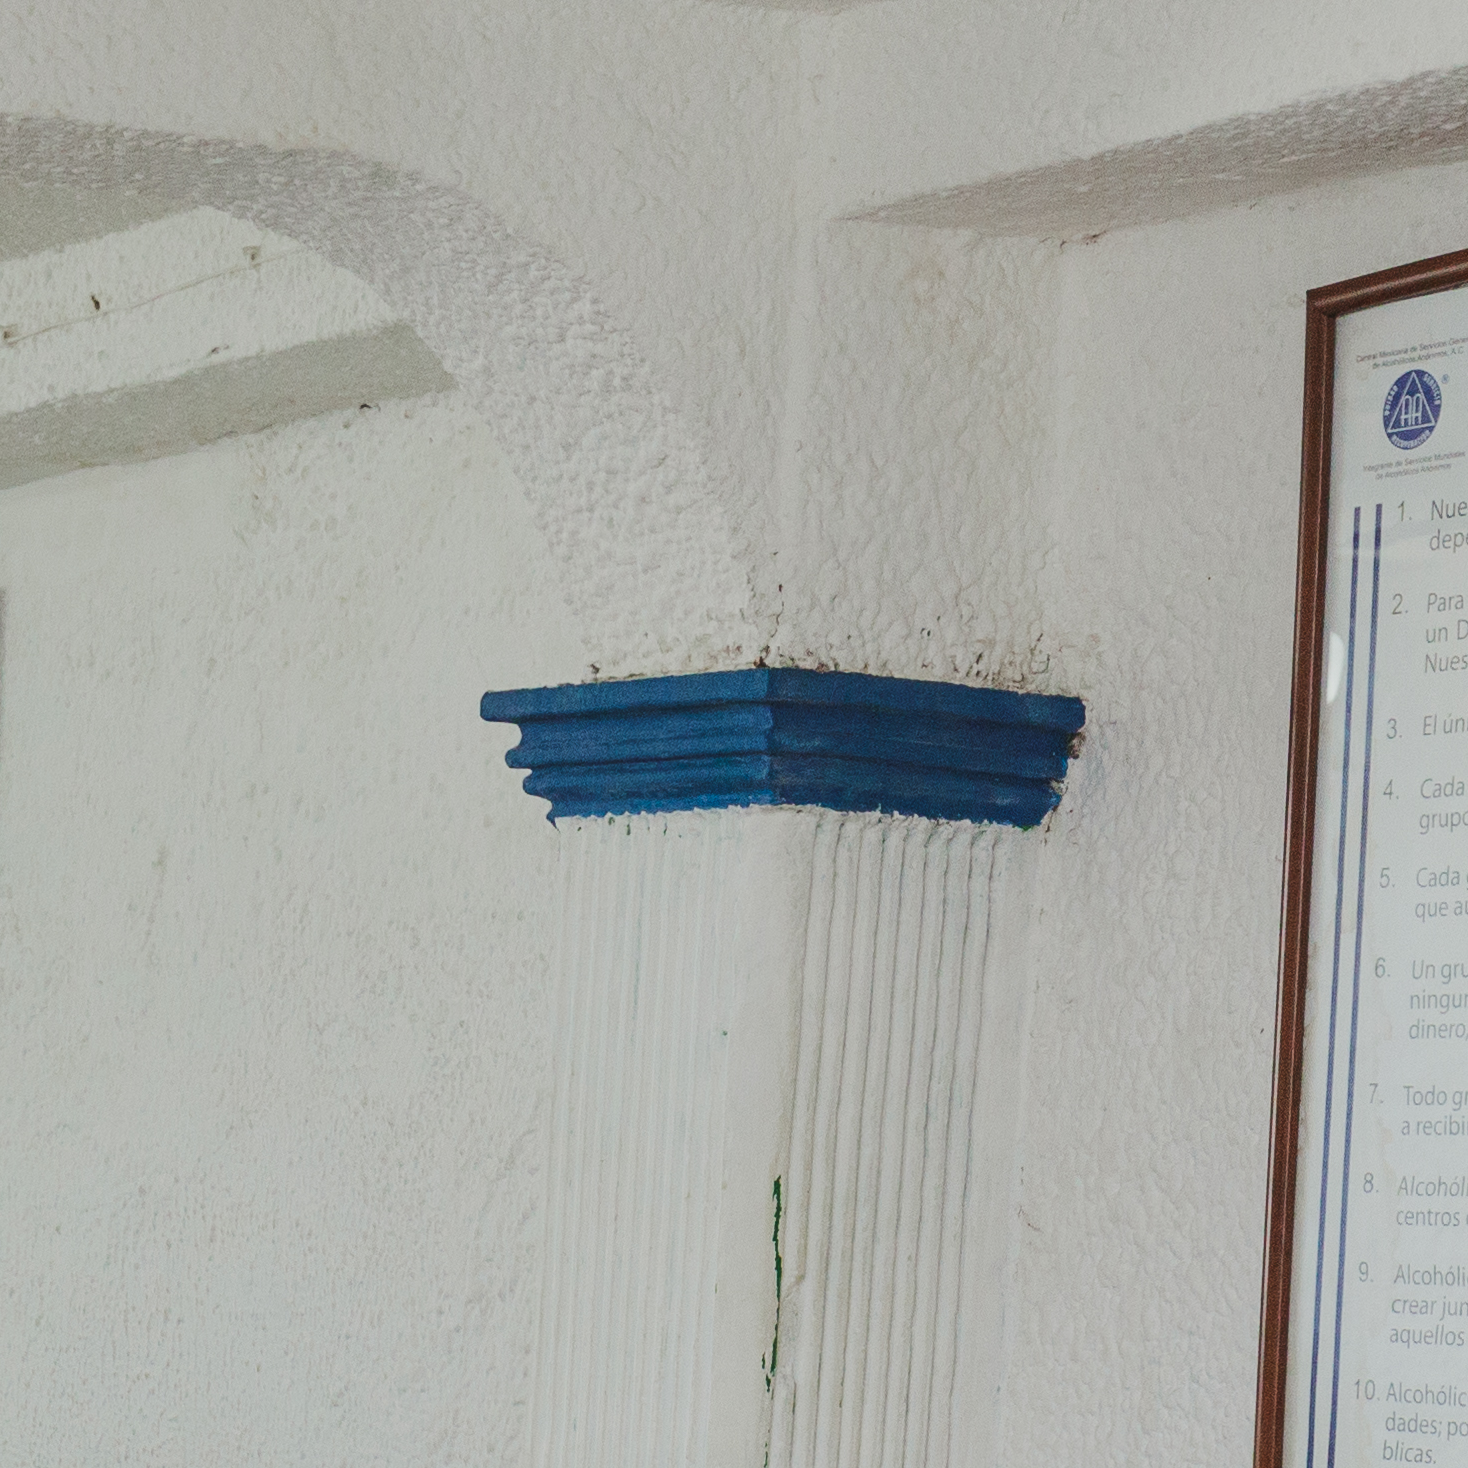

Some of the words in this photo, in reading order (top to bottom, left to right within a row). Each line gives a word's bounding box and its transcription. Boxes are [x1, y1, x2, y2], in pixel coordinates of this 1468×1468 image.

[1401, 393, 1423, 427] AA
[1397, 501, 1413, 521] 1.
[1429, 528, 1468, 553] dep
[1391, 593, 1409, 615] 2.
[1427, 592, 1464, 614] Para
[1425, 626, 1448, 643] un
[1386, 718, 1403, 739] 3.
[1422, 714, 1438, 736] El
[1443, 713, 1468, 734] ún
[1383, 779, 1399, 800] 4.
[1420, 776, 1465, 799] Cada
[1379, 867, 1395, 889] 5.
[1416, 865, 1461, 888] Cada
[1415, 901, 1449, 923] que
[1375, 957, 1391, 978] 6.
[1412, 960, 1436, 980] Un
[1369, 1083, 1384, 1104] 7.
[1403, 1084, 1448, 1106] Todo
[1401, 1121, 1411, 1136] a
[1363, 1173, 1379, 1194] 8.
[1396, 1210, 1461, 1227] centros
[1358, 1262, 1374, 1283] 9.
[1394, 1264, 1468, 1287] Alcohóli
[1391, 1299, 1437, 1315] crear
[1389, 1325, 1465, 1349] aquellos
[1354, 1379, 1380, 1400] 10.
[1385, 1411, 1442, 1437] dades;
[1382, 1439, 1437, 1465] blicas.
